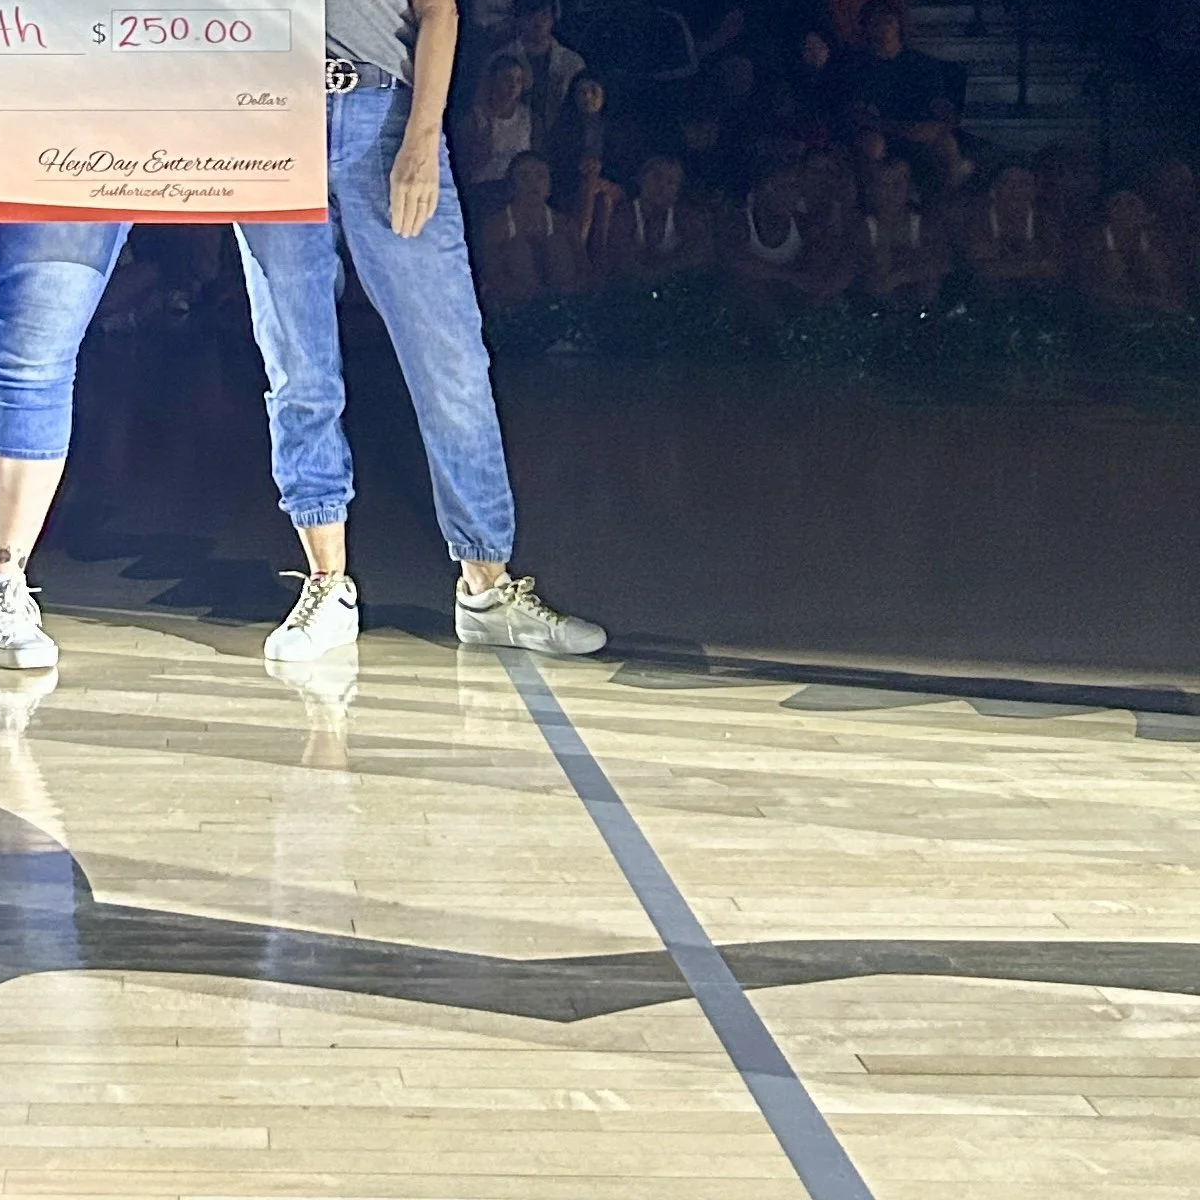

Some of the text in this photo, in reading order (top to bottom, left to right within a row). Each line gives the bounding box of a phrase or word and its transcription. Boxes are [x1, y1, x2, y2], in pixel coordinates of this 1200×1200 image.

[92, 16, 253, 48] $ 250.00
[236, 93, 287, 107] Dollars
[38, 147, 296, 175] HeyDay Entertainment
[89, 184, 235, 203] Authorized Signature
